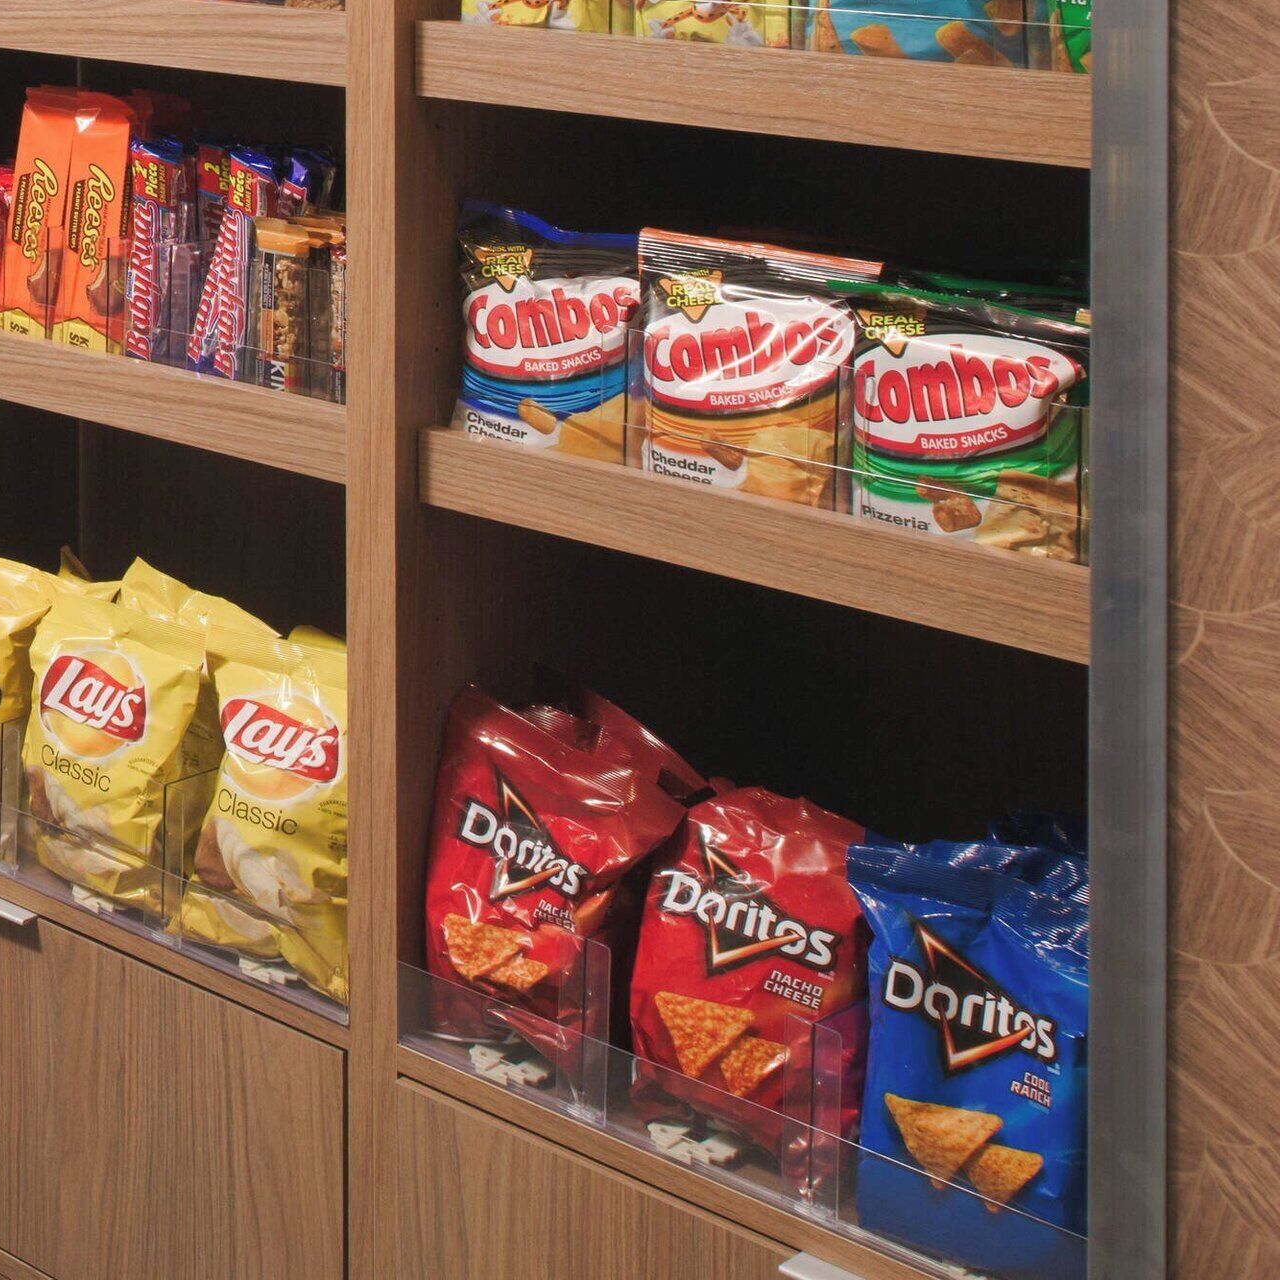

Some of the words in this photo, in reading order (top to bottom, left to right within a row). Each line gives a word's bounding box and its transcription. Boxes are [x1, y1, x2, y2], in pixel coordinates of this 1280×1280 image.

[233, 170, 246, 207] Piece
[22, 158, 58, 261] Reese's
[81, 164, 115, 271] Reese's
[666, 293, 721, 308] CHEESE
[671, 283, 714, 296] REAL
[468, 287, 640, 352] Combos
[870, 313, 918, 327] REAL
[524, 359, 558, 373] BAKED
[561, 349, 602, 371] SNACKS
[645, 312, 843, 384] Combos
[709, 394, 745, 407] BAKED
[749, 385, 792, 403] SNACKS
[854, 343, 1059, 424] Combos
[466, 411, 528, 440] Cheddar
[920, 437, 958, 451] BAKED
[961, 428, 1008, 449] SNACKS
[651, 449, 716, 477] Cheddar
[862, 504, 930, 533] Pizzeria
[43, 658, 142, 735] Lay's
[221, 701, 336, 775] Lay's
[40, 743, 112, 793] Classic
[217, 787, 299, 836] Classic
[461, 801, 583, 896] Doritos
[662, 873, 836, 966] Doritos
[763, 980, 822, 1010] CHEESE
[770, 970, 824, 996] NACHO
[885, 960, 1058, 1060] Doritos
[1010, 1080, 1052, 1108] RANCH
[1024, 1072, 1051, 1094] COOL
